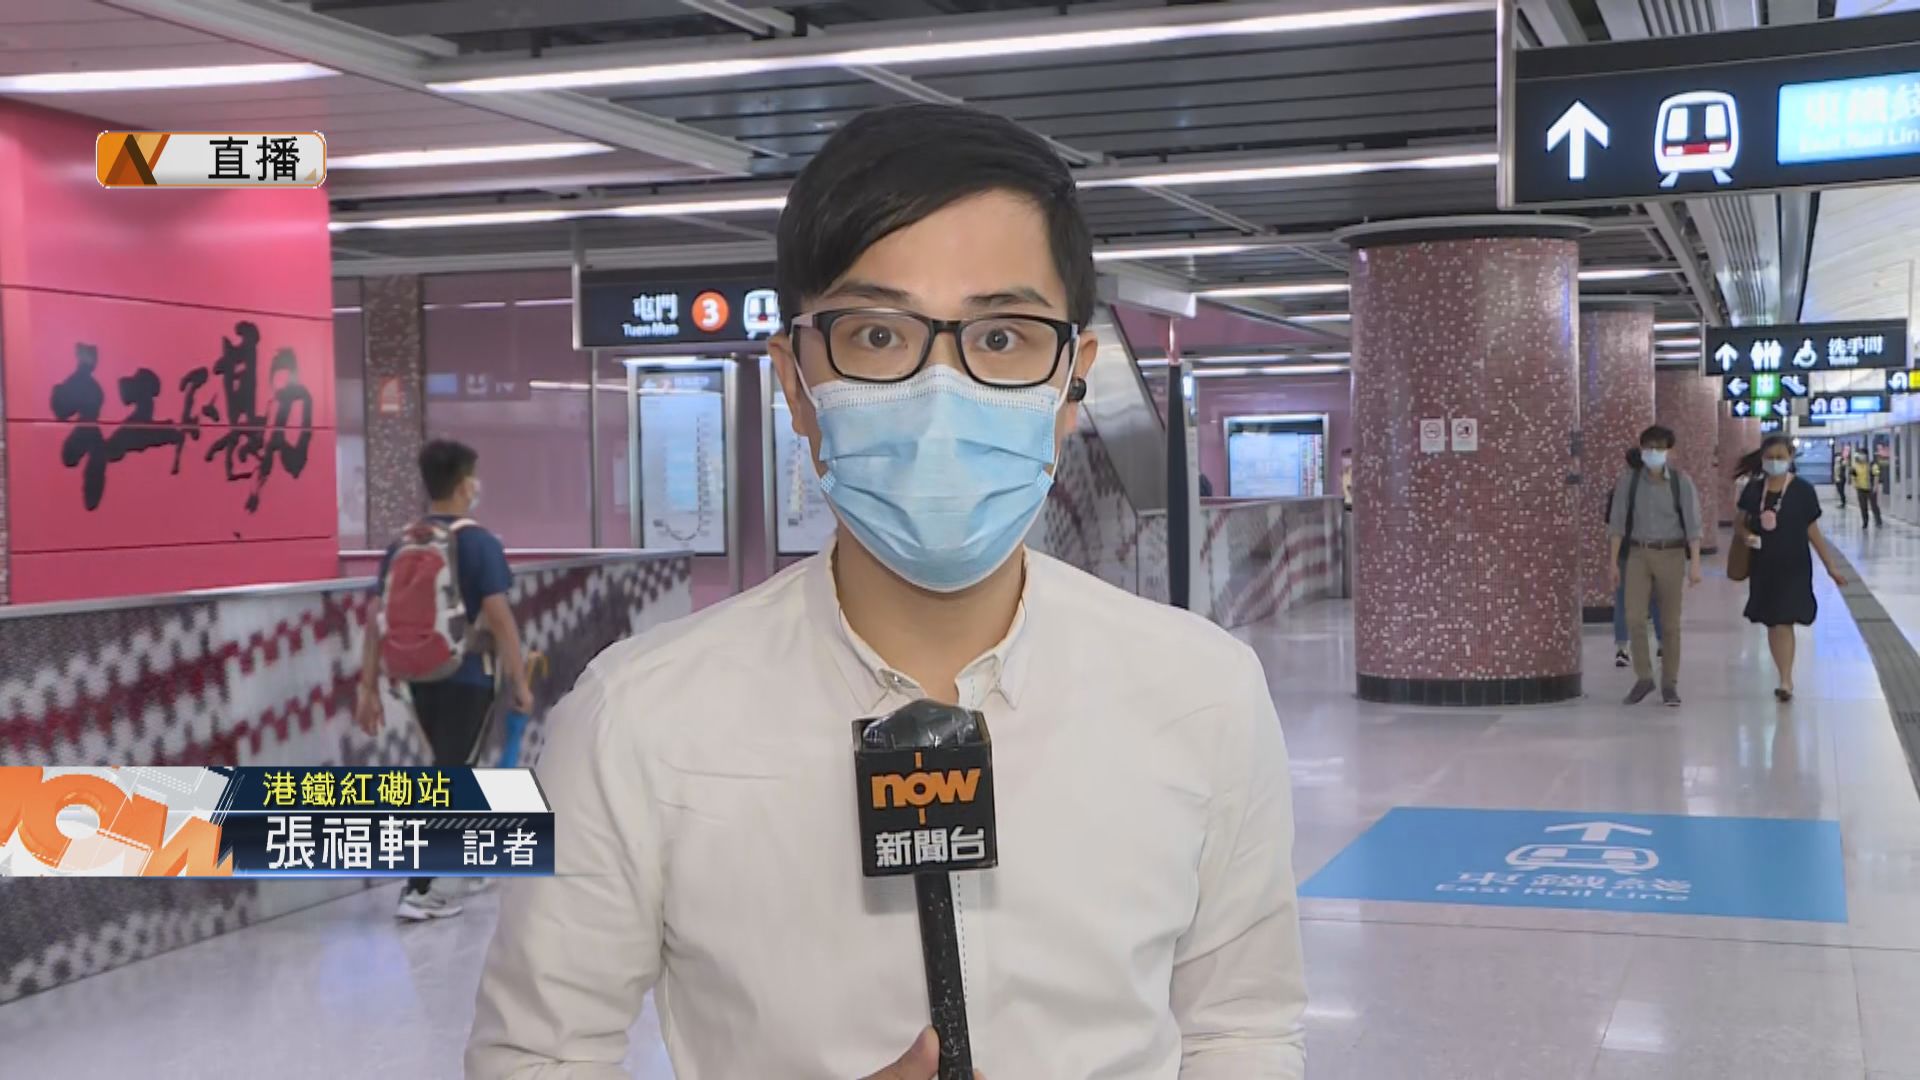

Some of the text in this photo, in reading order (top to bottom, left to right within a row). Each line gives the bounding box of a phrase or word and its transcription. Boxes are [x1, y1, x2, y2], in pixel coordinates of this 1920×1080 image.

[631, 293, 678, 321] 屯門
[702, 298, 721, 328] 3
[622, 322, 680, 337] Tuen Mun
[1828, 335, 1883, 356] 洗手間
[871, 767, 982, 810] now
[875, 825, 985, 867] 新聞台
[1435, 883, 1689, 901] East Rail Line
